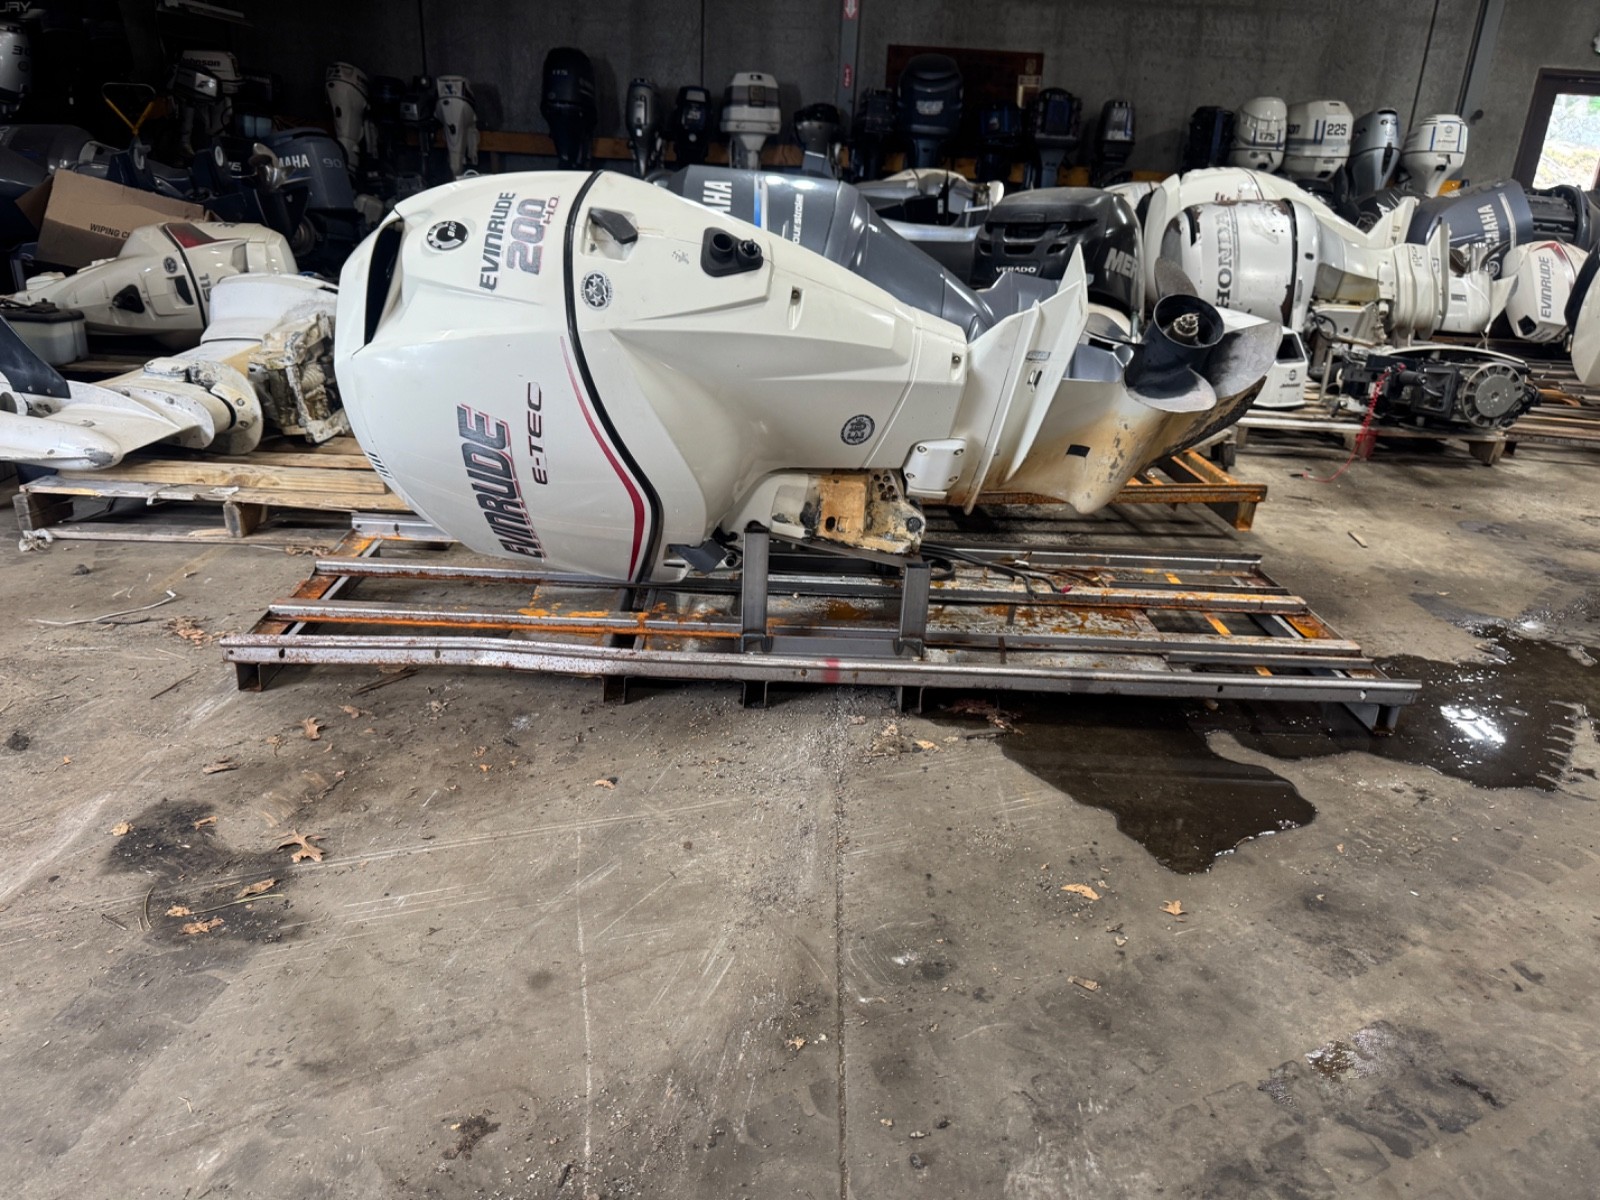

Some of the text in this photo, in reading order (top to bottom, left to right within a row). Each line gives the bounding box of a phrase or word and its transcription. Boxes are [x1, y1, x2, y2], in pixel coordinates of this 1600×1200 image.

[322, 157, 343, 168] 90
[1326, 124, 1347, 136] 225
[90, 222, 120, 237] WIPING
[479, 192, 517, 291] EVINRUDE
[506, 198, 547, 276] 200
[1215, 208, 1233, 308] HONDA
[1538, 256, 1552, 319] EVINRUDE
[527, 381, 549, 485] E-TEC
[457, 403, 547, 559] EVINRUDE
